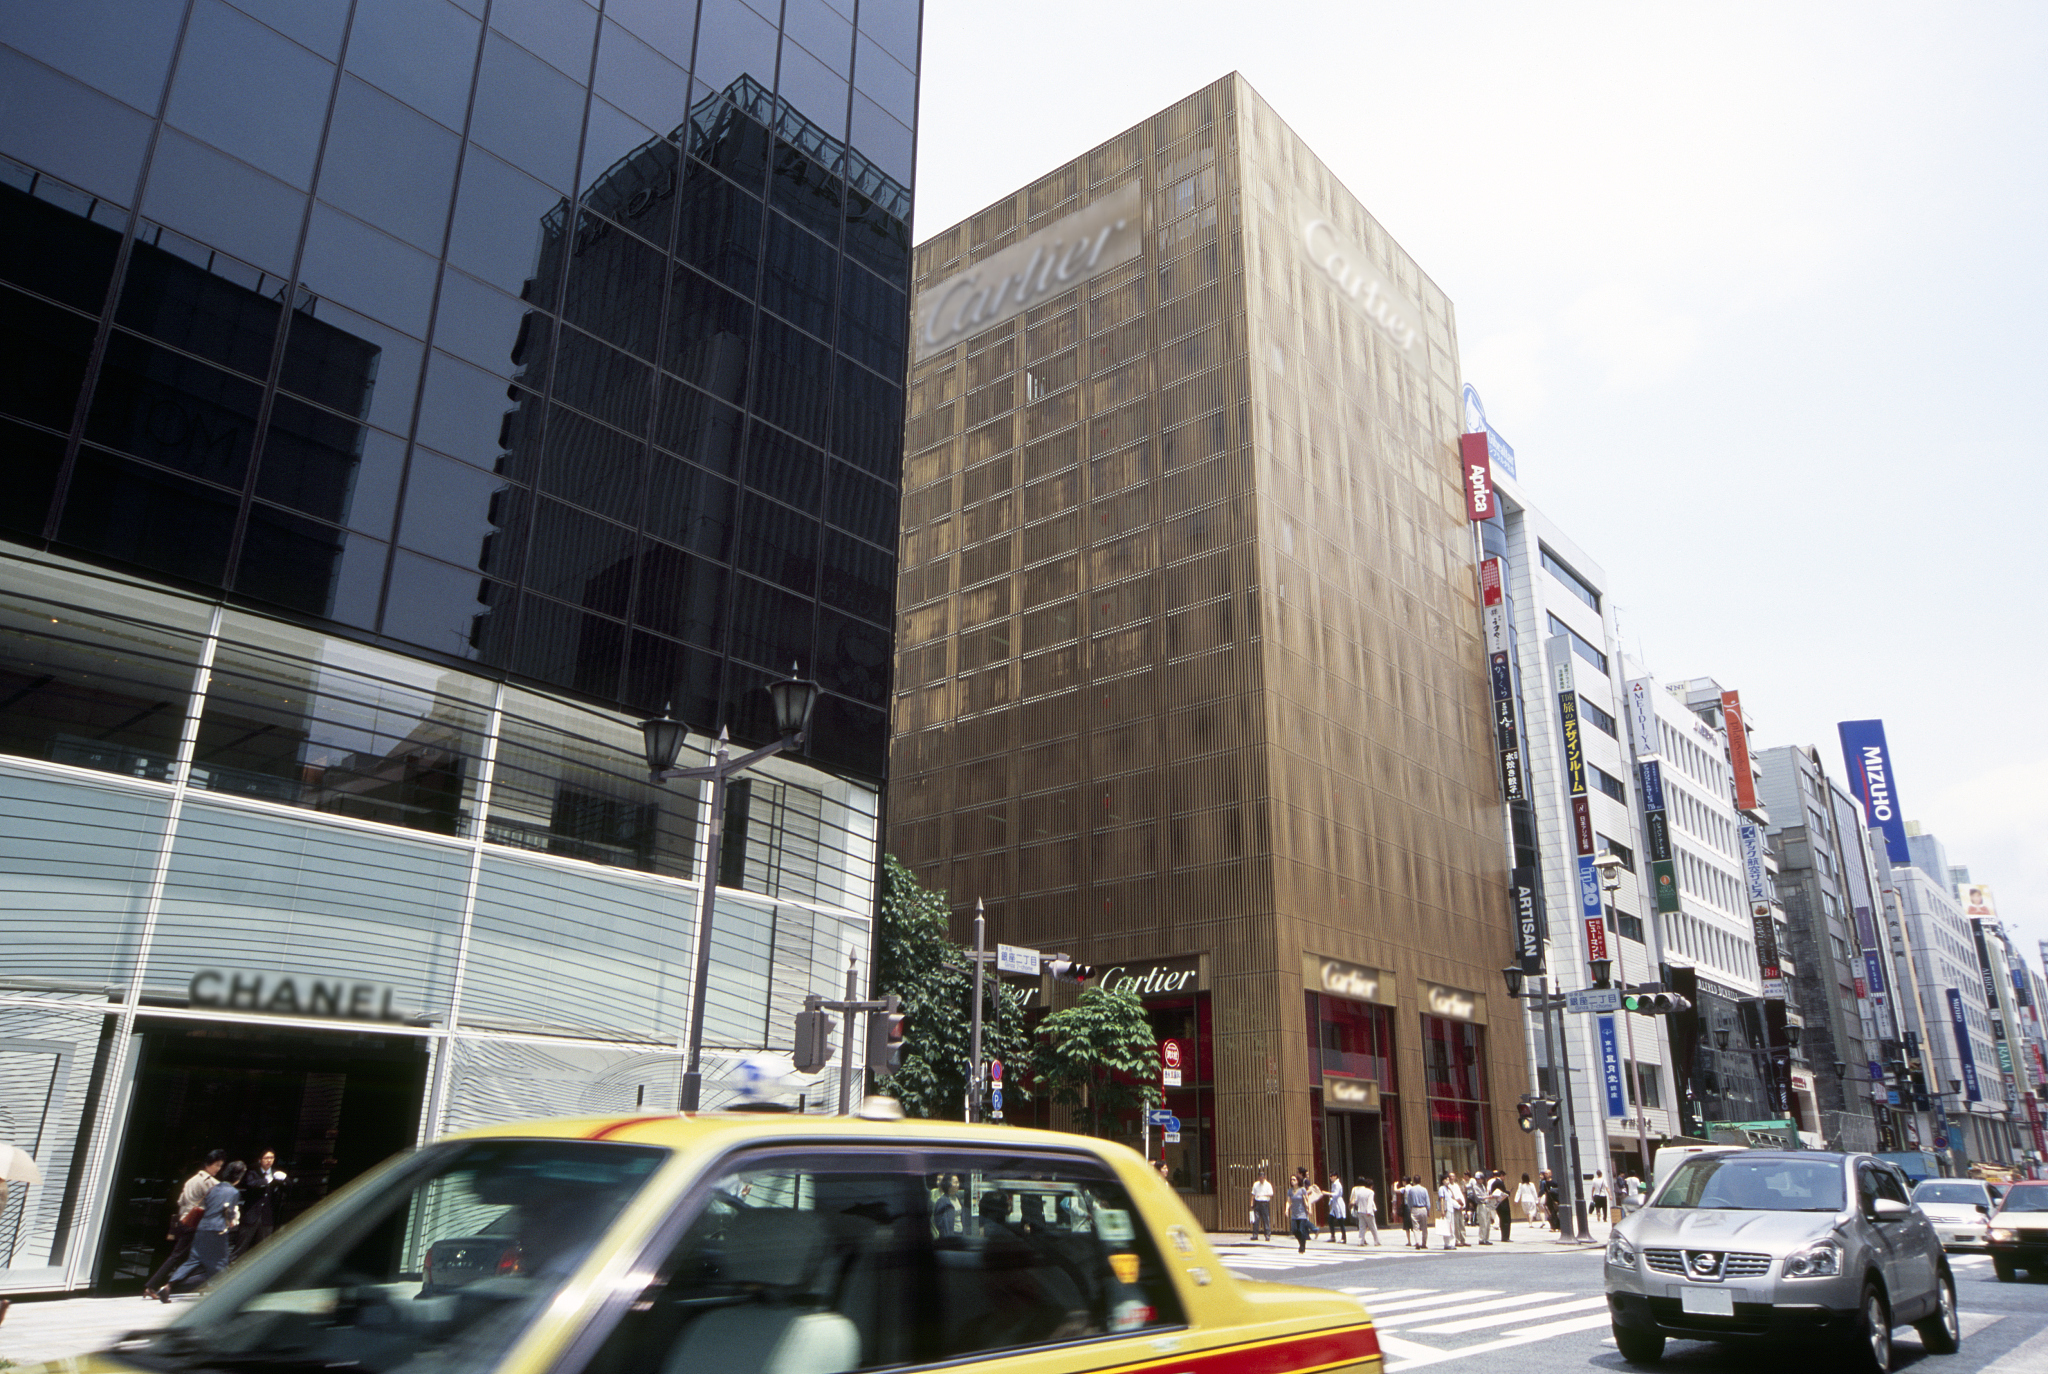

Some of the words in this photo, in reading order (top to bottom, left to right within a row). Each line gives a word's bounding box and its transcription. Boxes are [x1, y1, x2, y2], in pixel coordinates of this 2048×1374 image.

[924, 219, 1126, 345] Cartier
[1469, 464, 1490, 513] Aprica
[1634, 691, 1651, 751] MEIDIYA
[1862, 746, 1892, 821] MIZUHO
[1518, 886, 1538, 957] ARTISAN
[1001, 951, 1037, 966] 銀座二丁目
[1321, 961, 1378, 998] Cartier
[188, 969, 401, 1022] CHANEL
[1100, 966, 1196, 998] Cartier
[1570, 994, 1617, 1006] 銀座二丁目
[1982, 967, 1996, 996] ALBION
[1952, 998, 1963, 1023] MIZUHO
